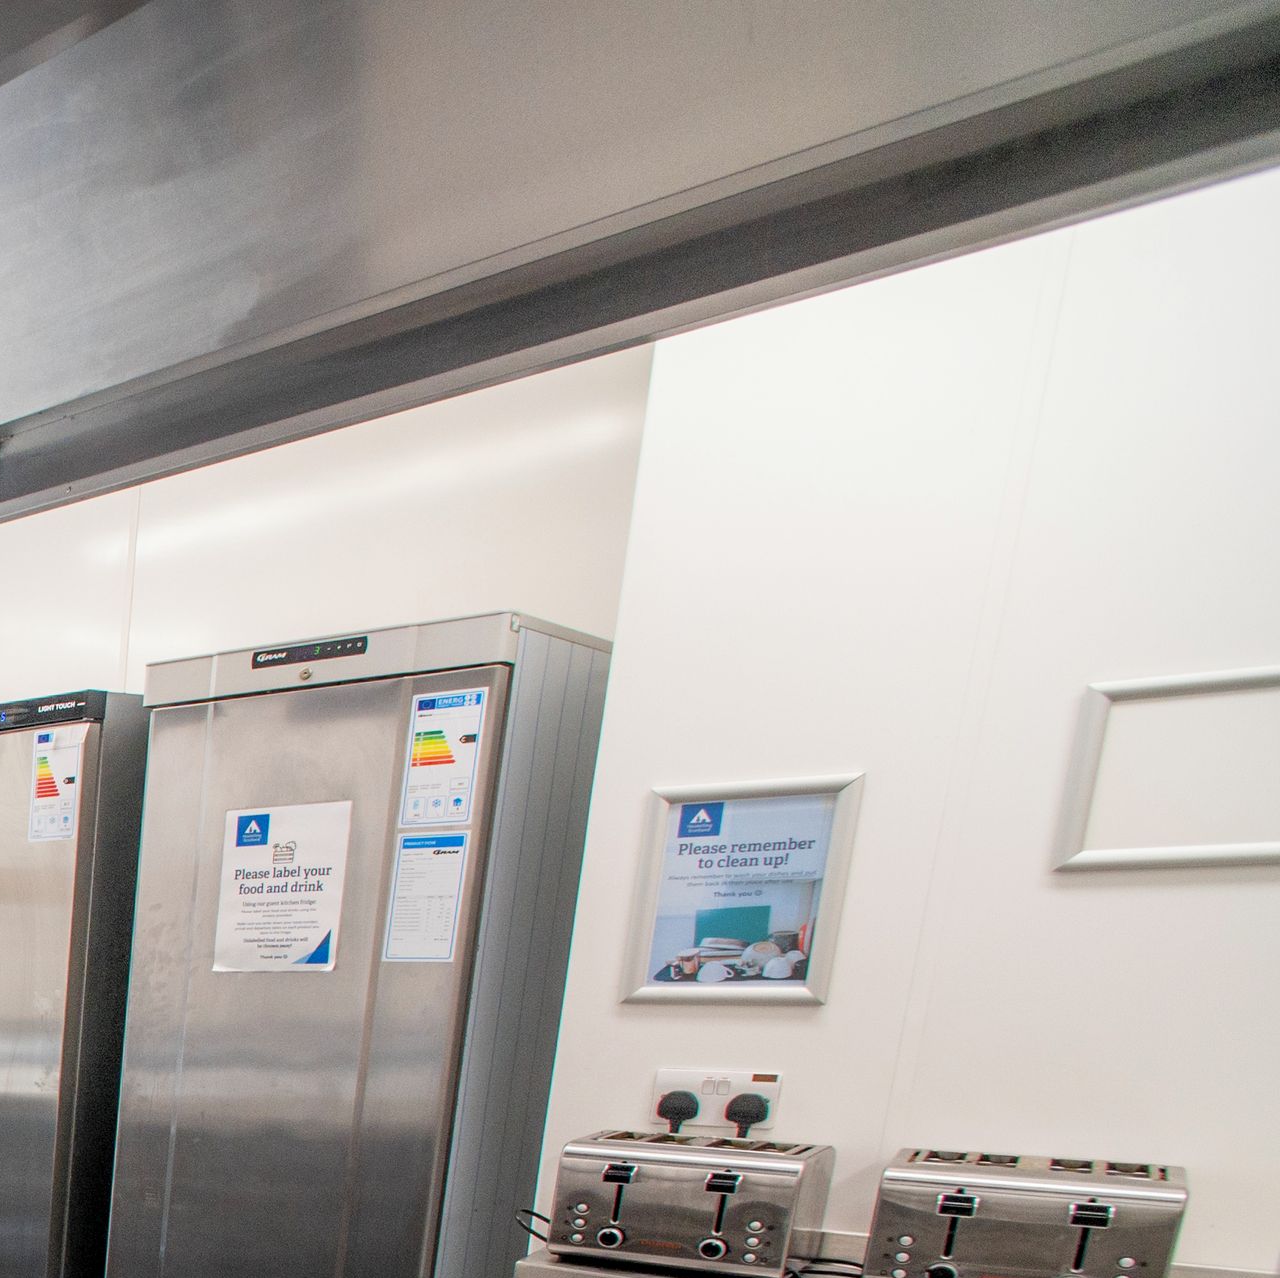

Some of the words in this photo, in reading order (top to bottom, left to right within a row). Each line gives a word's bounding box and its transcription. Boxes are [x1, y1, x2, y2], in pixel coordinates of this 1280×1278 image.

[38, 704, 55, 713] LIGHT
[55, 701, 76, 711] TOUCH
[678, 842, 727, 856] Please
[730, 838, 816, 854] remember
[698, 857, 713, 869] to
[717, 855, 759, 868] clean
[761, 853, 789, 869] up!
[234, 868, 270, 881] Please
[272, 866, 300, 879] label
[304, 867, 332, 880] your
[238, 882, 264, 895] food
[266, 881, 288, 893] and
[290, 880, 324, 893] drink
[713, 890, 737, 898] Thank
[738, 890, 752, 898] you
